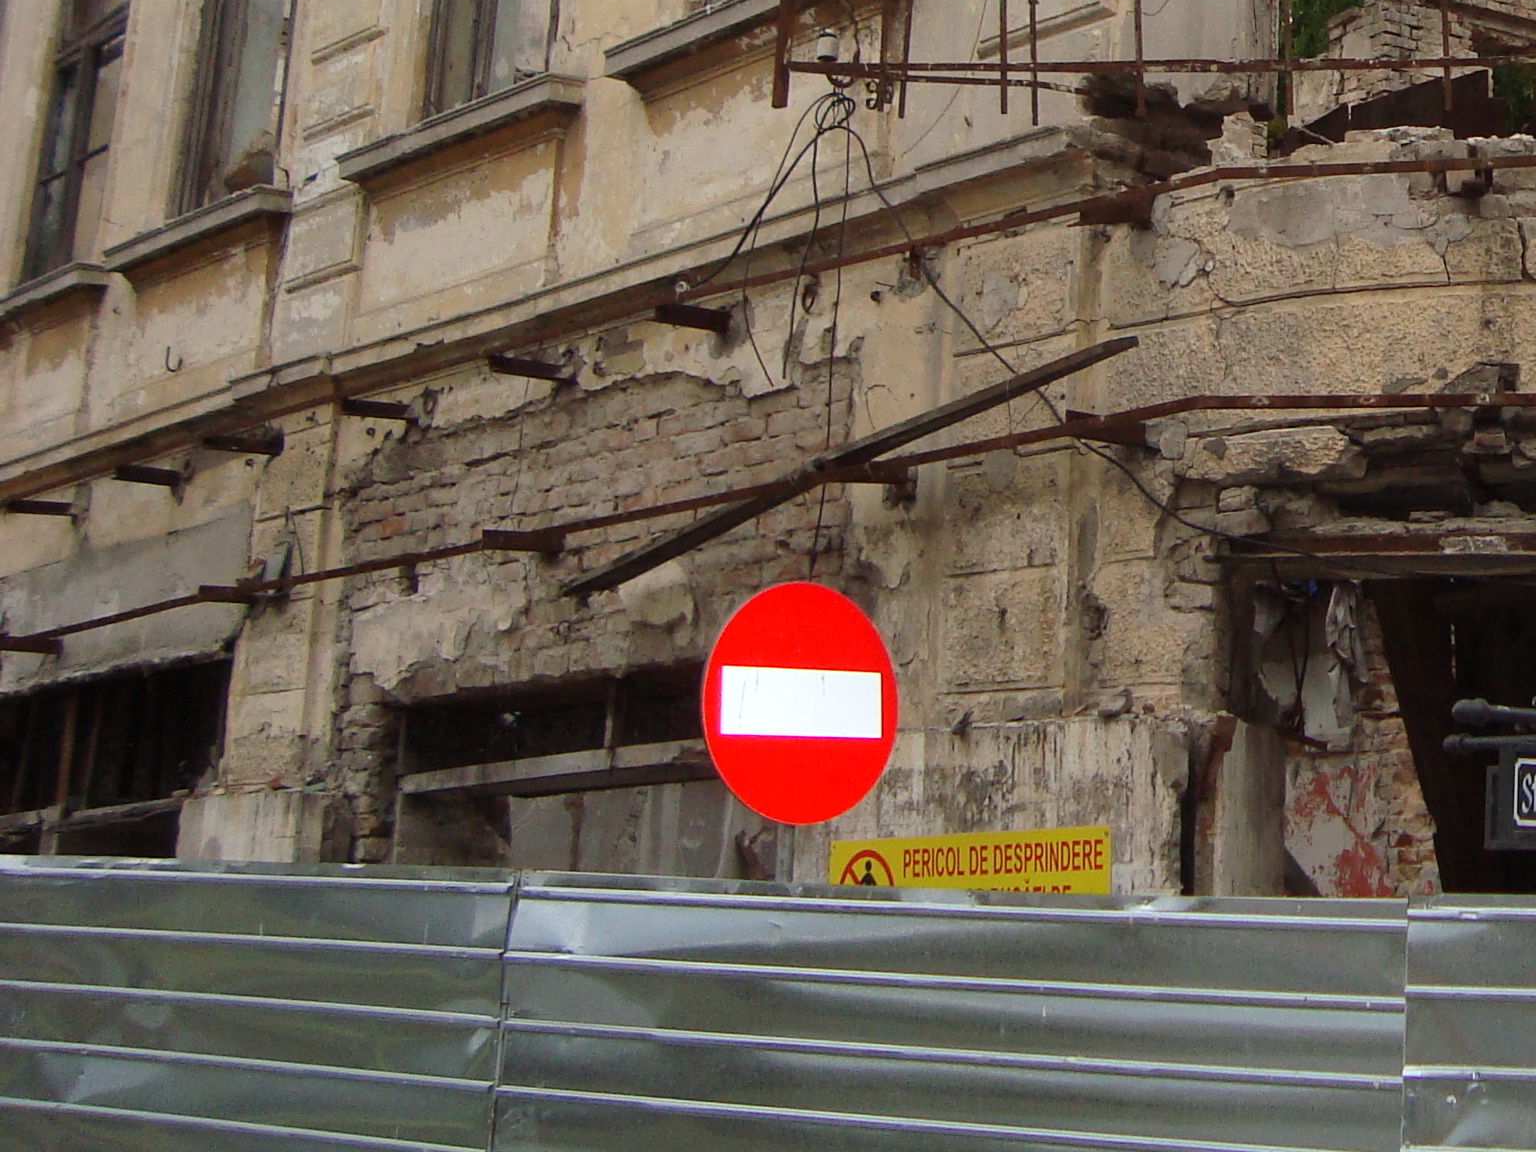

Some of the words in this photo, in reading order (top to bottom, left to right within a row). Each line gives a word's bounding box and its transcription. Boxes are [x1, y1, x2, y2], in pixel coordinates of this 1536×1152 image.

[903, 846, 965, 879] PERICOL
[969, 845, 988, 876] DE
[993, 839, 1104, 875] DESPRINDERE
